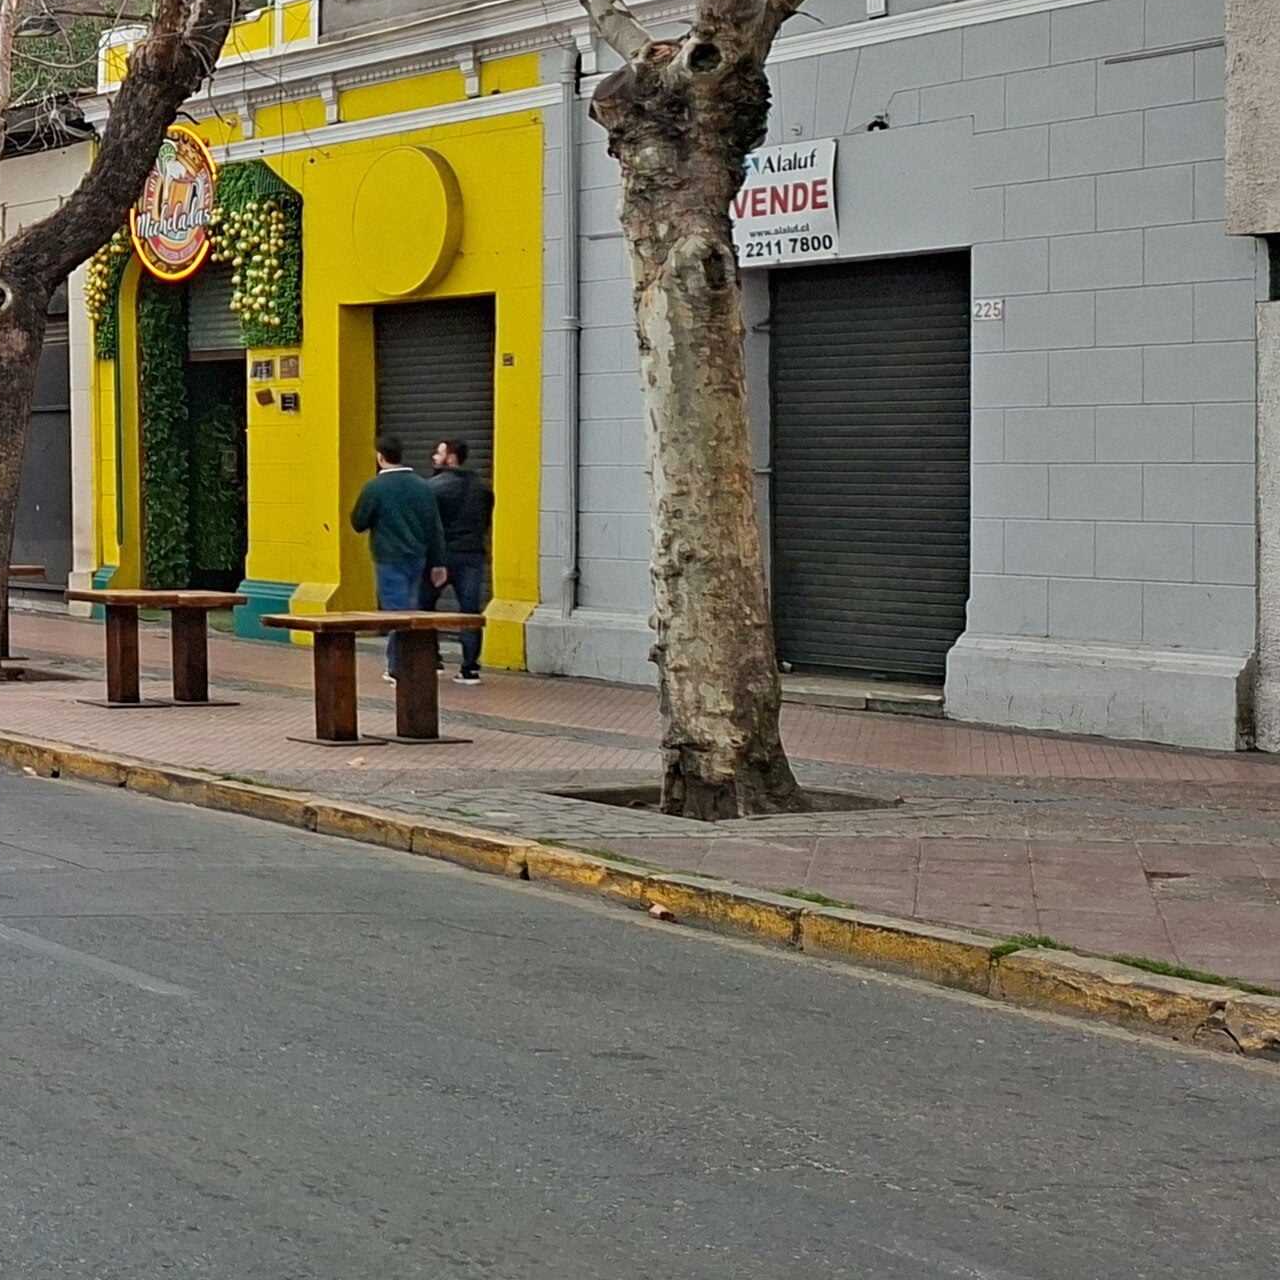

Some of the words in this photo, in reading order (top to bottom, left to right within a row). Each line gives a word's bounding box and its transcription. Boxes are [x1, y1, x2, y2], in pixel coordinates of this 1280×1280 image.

[762, 148, 818, 174] Alaluf
[732, 178, 829, 219] VENDE
[136, 196, 211, 239] Micheladas
[745, 239, 782, 258] 2211
[788, 234, 833, 254] 7800
[975, 301, 1001, 318] 225
